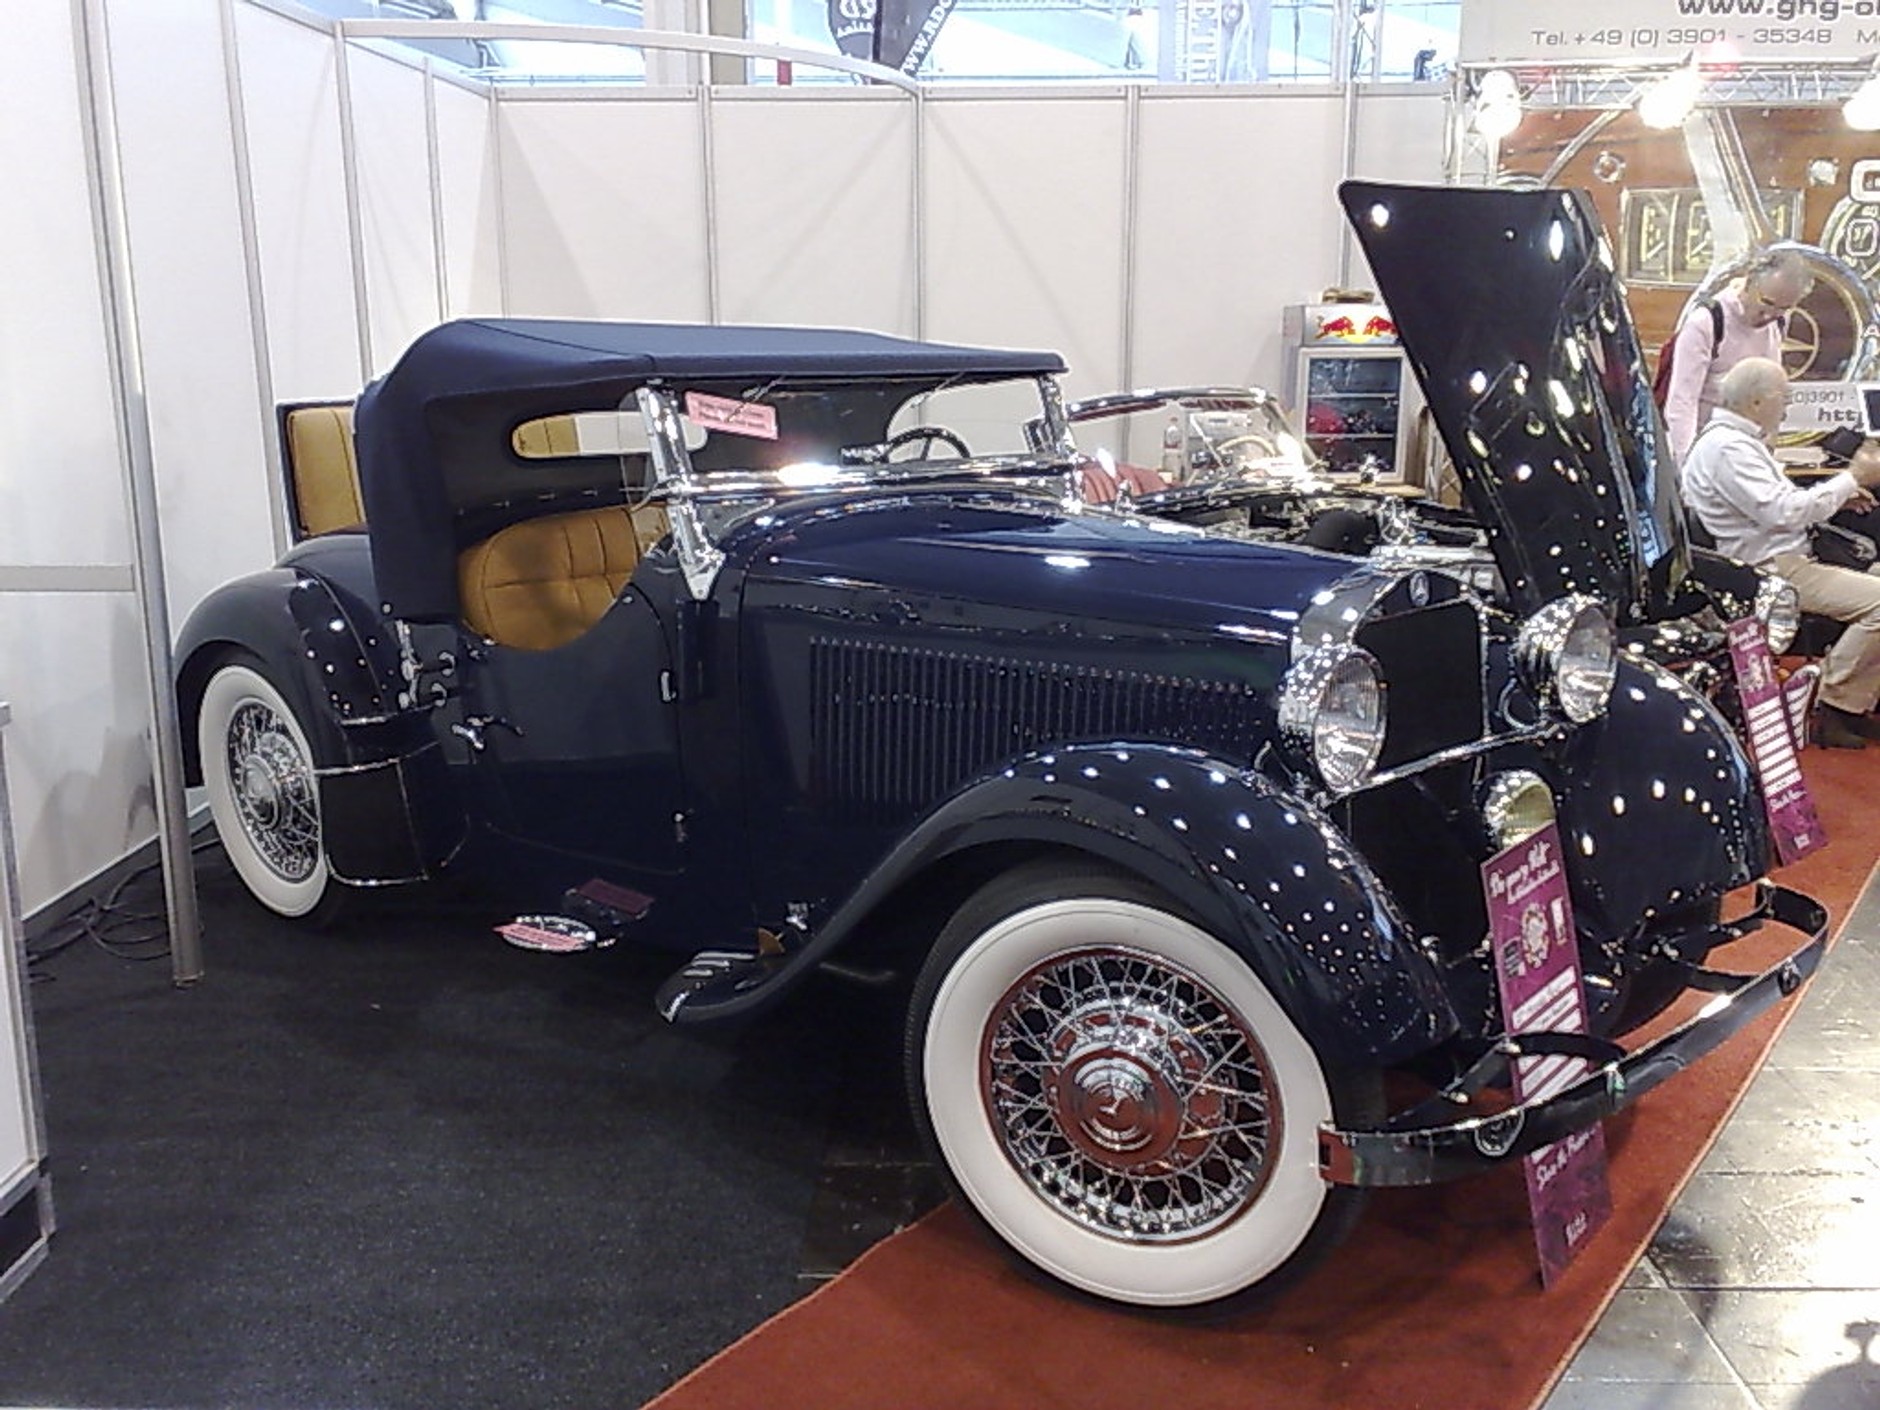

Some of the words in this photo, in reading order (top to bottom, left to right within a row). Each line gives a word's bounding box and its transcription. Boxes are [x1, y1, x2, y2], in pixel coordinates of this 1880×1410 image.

[1531, 31, 1567, 45] Tel.
[1630, 30, 1659, 48] (0)
[1666, 29, 1726, 44] 3901
[1753, 28, 1832, 44] 35348
